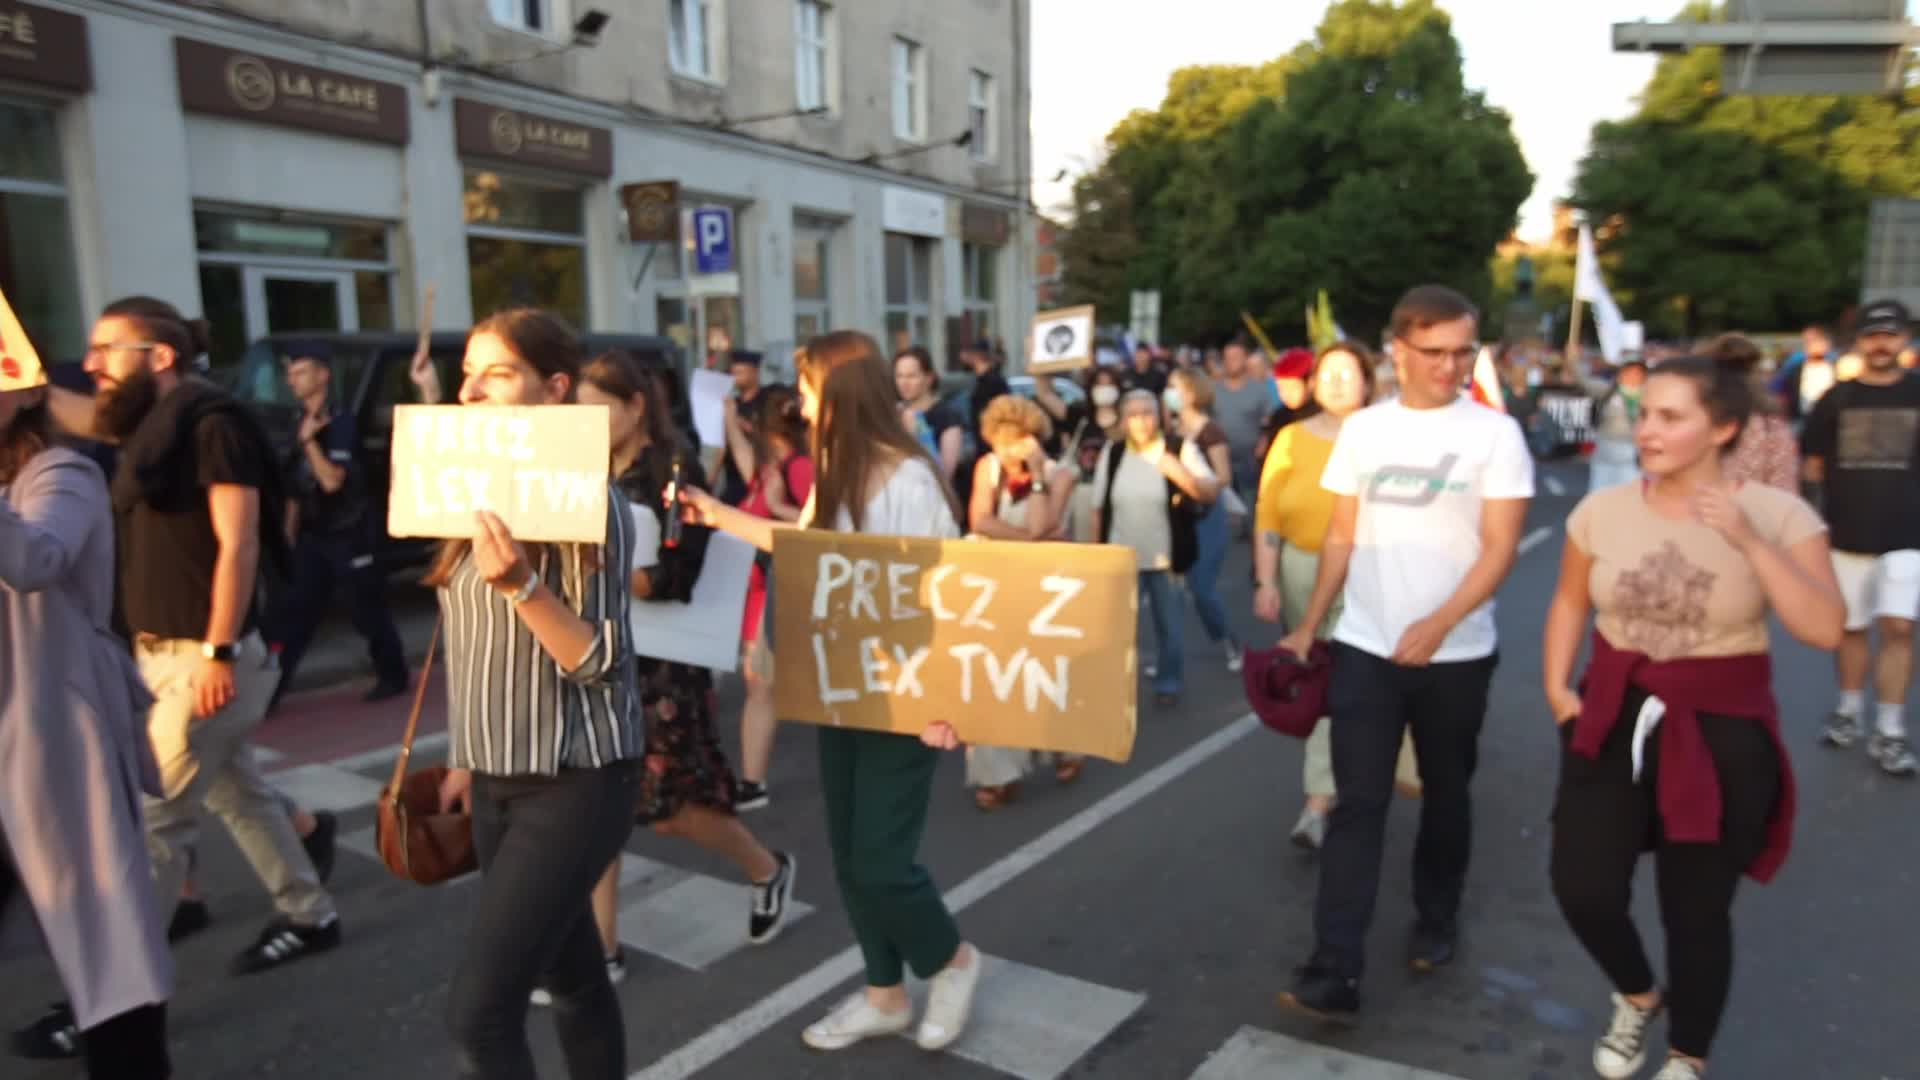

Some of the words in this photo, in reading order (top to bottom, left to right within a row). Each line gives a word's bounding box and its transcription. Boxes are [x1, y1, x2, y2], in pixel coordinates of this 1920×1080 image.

[279, 70, 313, 98] LA
[524, 120, 546, 139] LA
[701, 213, 724, 256] P
[411, 463, 493, 520] LEX
[812, 552, 997, 631] PRECZ
[1028, 574, 1086, 639] Z
[812, 633, 931, 705] LEX
[948, 643, 1071, 713] TVN
